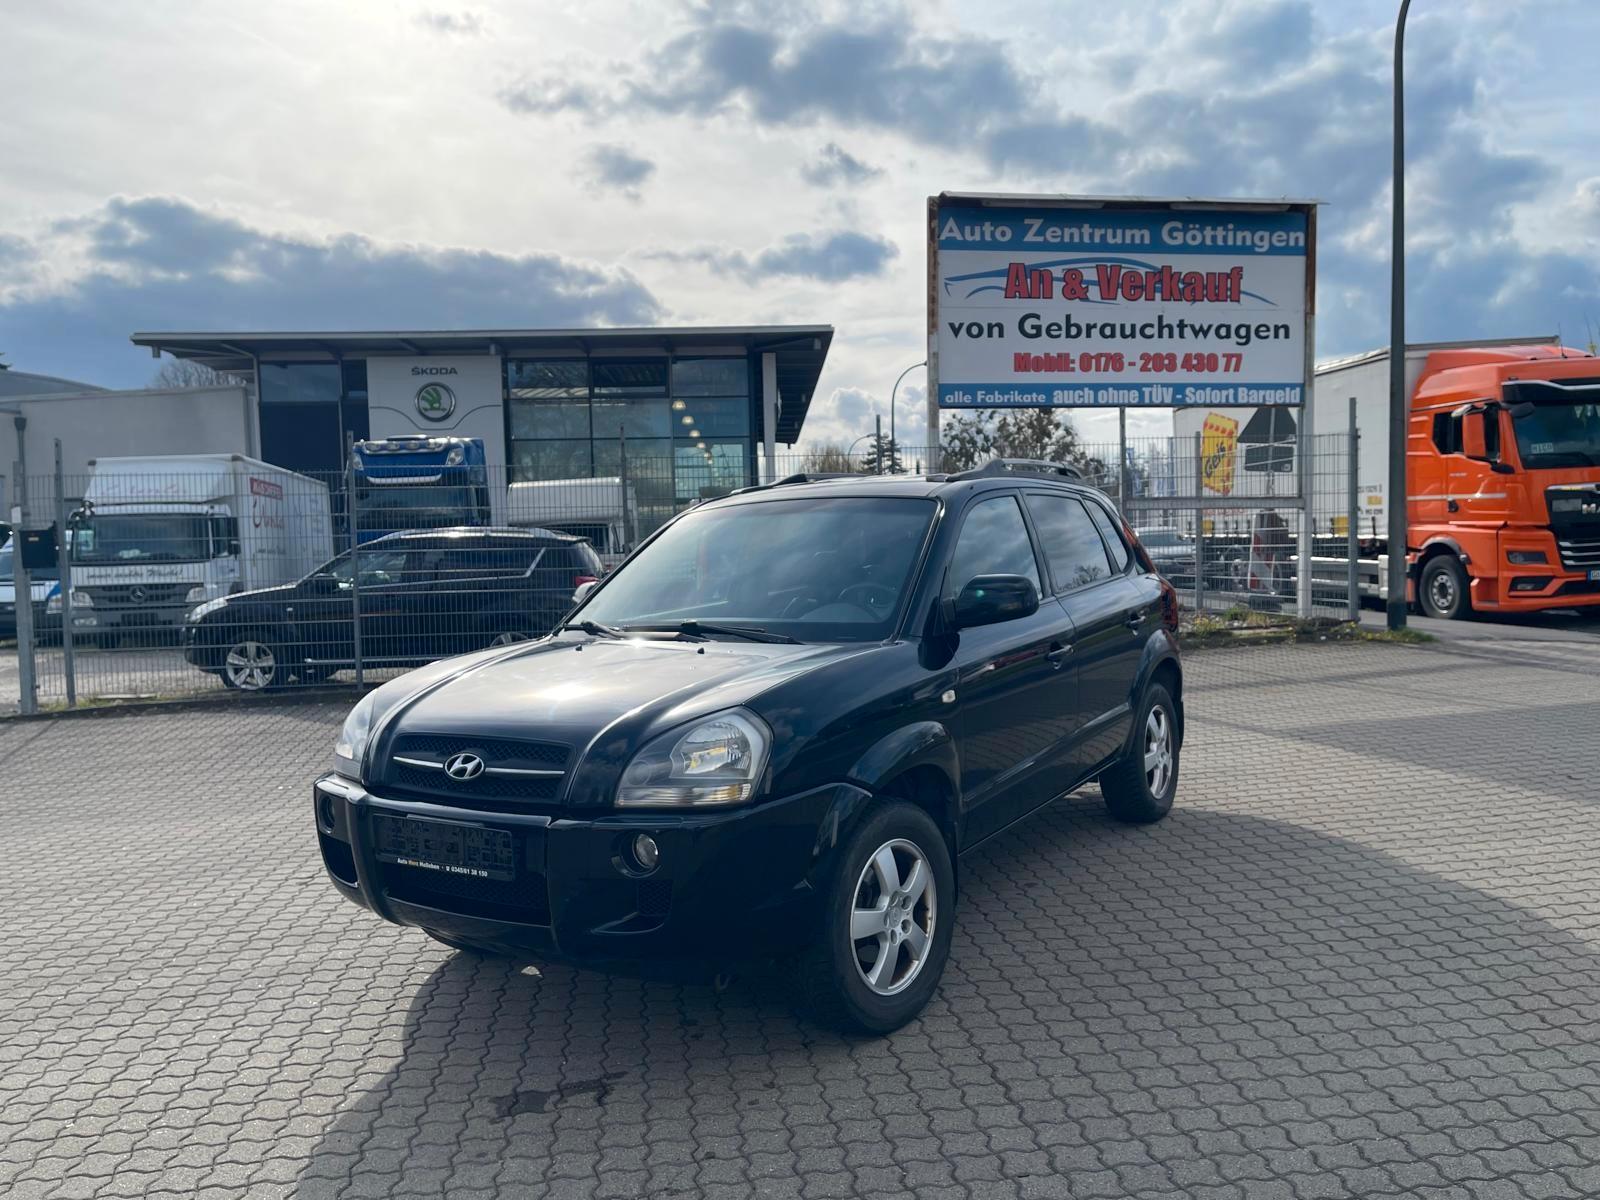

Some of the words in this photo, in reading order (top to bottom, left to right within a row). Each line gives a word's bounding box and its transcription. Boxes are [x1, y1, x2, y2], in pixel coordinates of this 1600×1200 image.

[939, 217, 1012, 242] Auto
[1023, 218, 1150, 245] Zentrum
[1160, 221, 1305, 252] Göttingen
[1004, 262, 1053, 299] An
[1062, 268, 1089, 300] &
[1096, 264, 1243, 303] Verkauf
[948, 322, 1005, 339] von
[1018, 312, 1291, 346] Gebrauchtwagen
[411, 366, 458, 376] ŠKODA
[1014, 352, 1076, 373] Mobil:
[1079, 352, 1124, 373] 0176
[1139, 352, 1177, 373] 203
[1180, 353, 1219, 373] 430
[1222, 353, 1243, 373] 77
[945, 390, 972, 404] alle
[977, 391, 1046, 403] Fabrikate
[1053, 388, 1094, 404] auch
[1098, 388, 1139, 405] ohne
[1143, 385, 1173, 404] TÜV
[1185, 387, 1234, 404] Sofort
[1237, 387, 1301, 405] Bargeld
